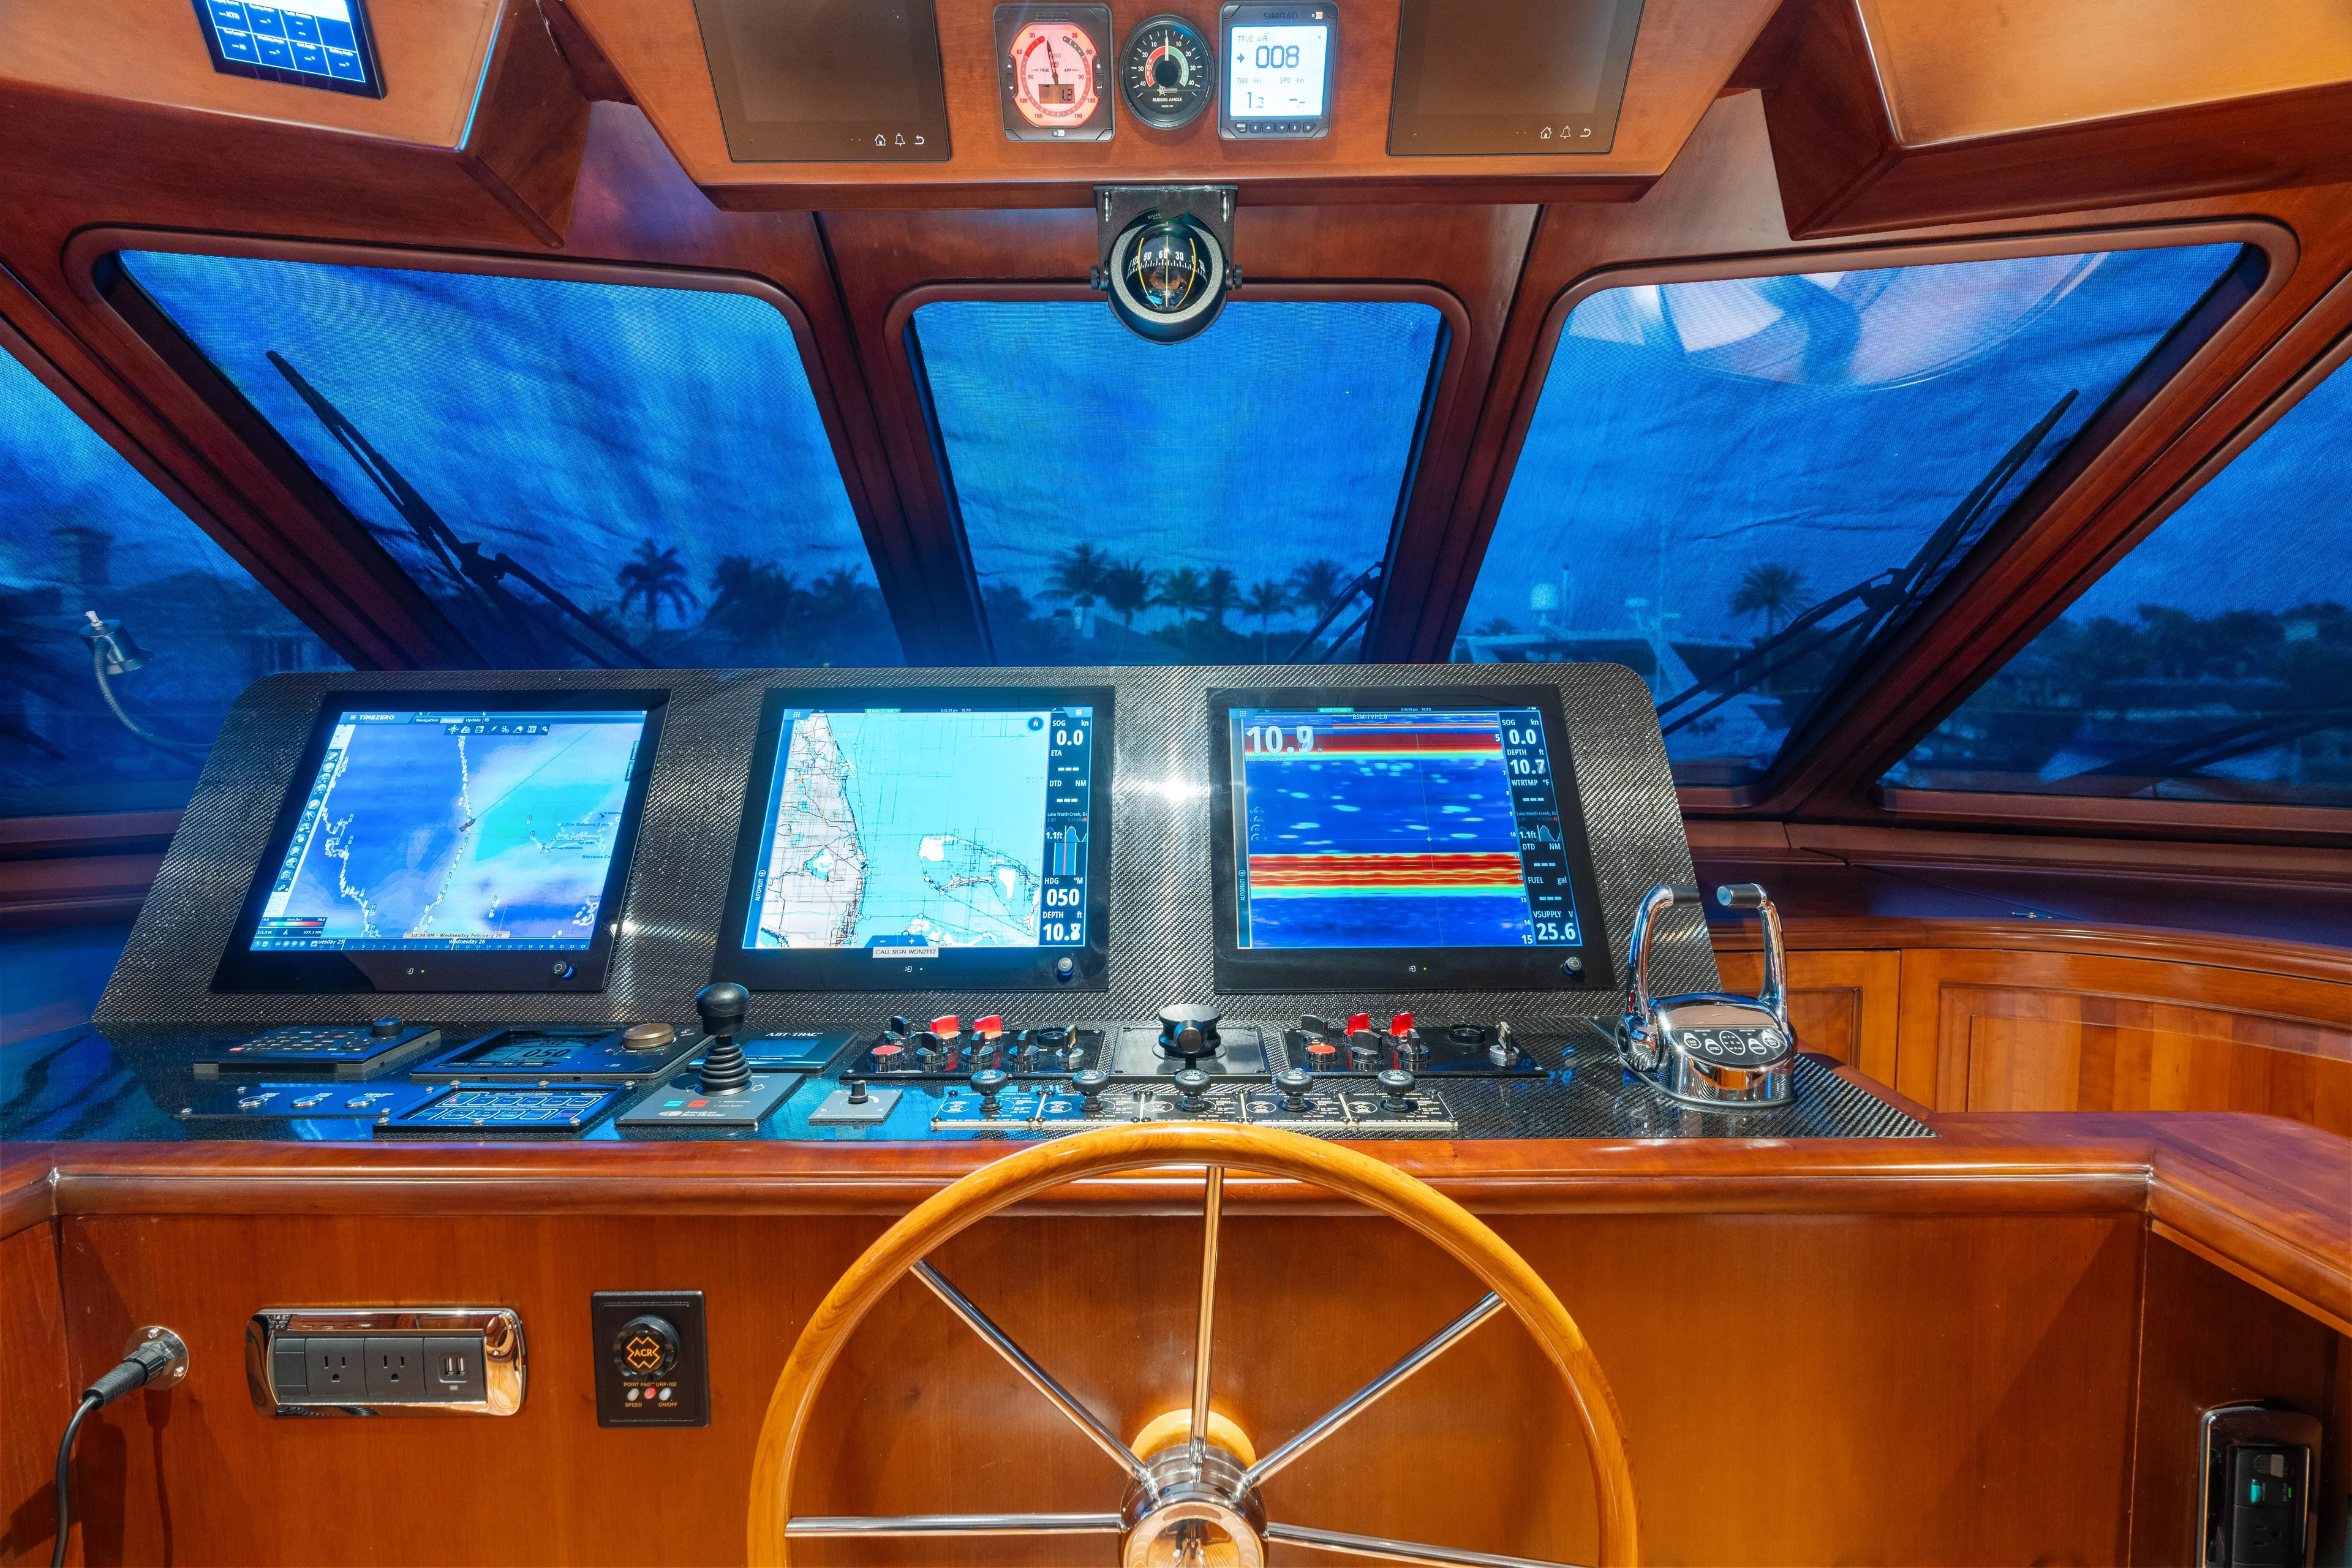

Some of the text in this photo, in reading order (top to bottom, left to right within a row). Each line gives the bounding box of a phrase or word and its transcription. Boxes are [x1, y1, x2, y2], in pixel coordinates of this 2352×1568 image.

[1263, 12, 1298, 20] SIMRAD
[1256, 45, 1300, 69] 008
[1061, 88, 1073, 101] 1.2
[1247, 92, 1264, 108] 1.3
[1144, 251, 1152, 261] 90
[1175, 251, 1184, 261] 30
[1057, 729, 1084, 745] 0.0
[1509, 729, 1536, 745] 0.0
[1557, 876, 1567, 886] gal
[755, 878, 764, 902] AUTOPILOT
[1046, 888, 1080, 907] 050
[1536, 922, 1576, 940] 25.6
[1521, 935, 1533, 944] 15
[522, 1049, 571, 1057] 050
